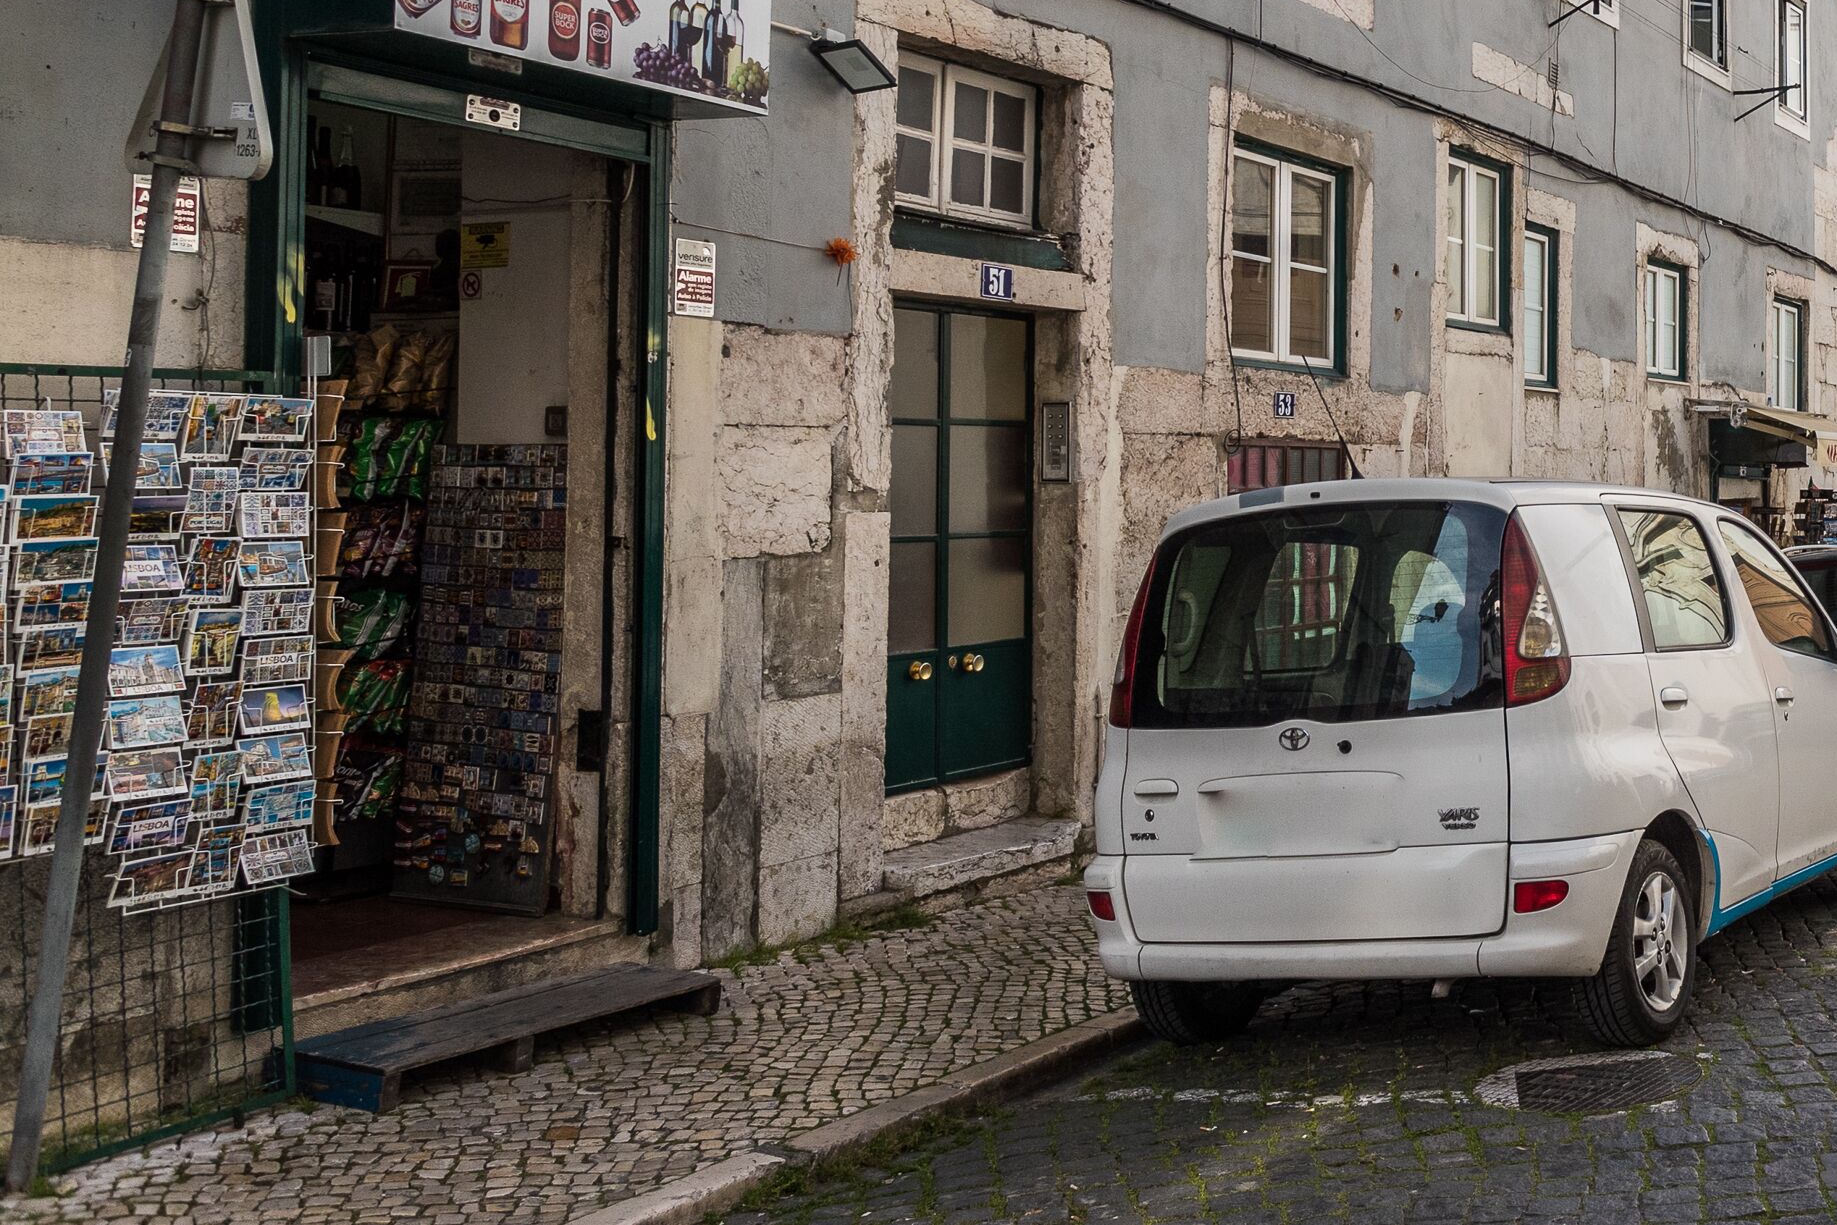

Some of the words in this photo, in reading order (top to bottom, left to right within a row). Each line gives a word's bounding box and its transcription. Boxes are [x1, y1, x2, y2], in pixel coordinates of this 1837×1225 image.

[554, 10, 576, 22] SUPER
[555, 19, 575, 29] BOCK
[679, 270, 712, 283] Alarme
[988, 267, 1006, 296] 51
[1278, 394, 1292, 416] 53
[260, 655, 294, 665] LISBOA
[1437, 807, 1480, 822] YARIS
[133, 819, 169, 833] LISBOA
